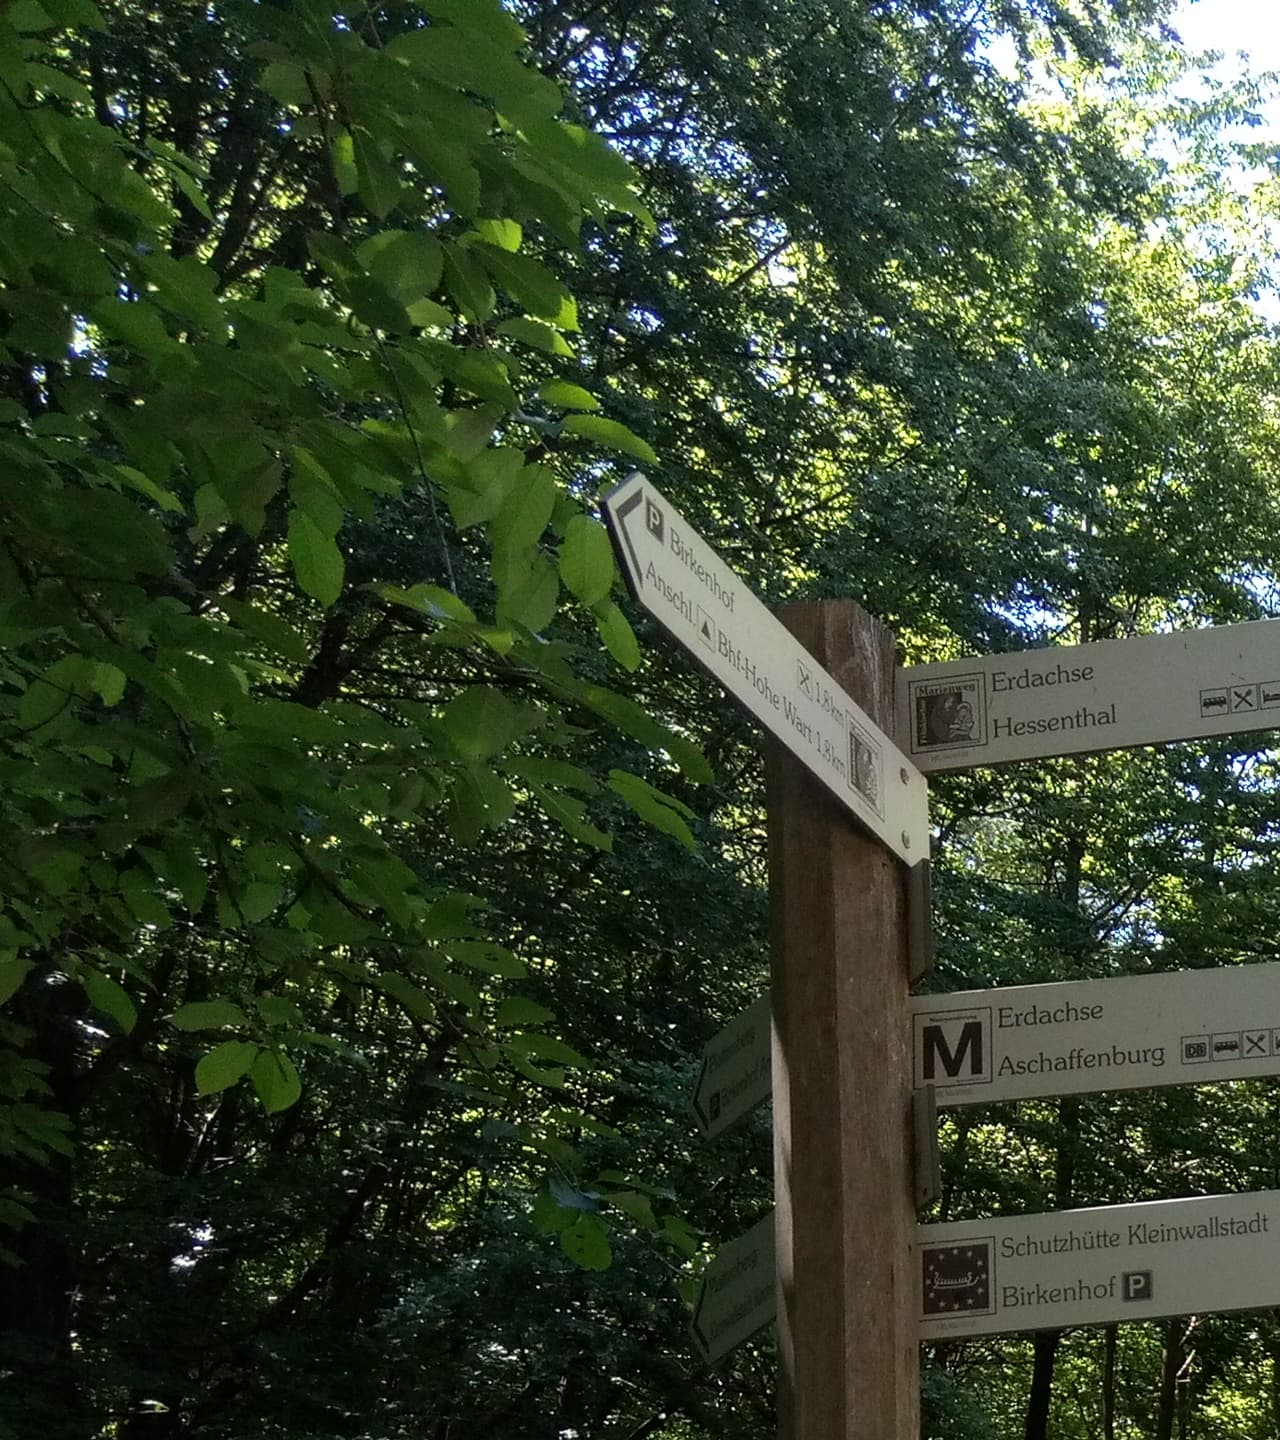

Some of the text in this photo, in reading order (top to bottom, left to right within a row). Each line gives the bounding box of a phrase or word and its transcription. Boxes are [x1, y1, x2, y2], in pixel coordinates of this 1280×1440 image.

[670, 527, 735, 613] Birkenhof
[646, 561, 696, 626] Anschl.
[783, 696, 812, 744] Wart
[992, 664, 1094, 692] Erdachse
[993, 703, 1117, 738] Hessenthal
[998, 1002, 1104, 1028] Erdachse
[922, 1021, 983, 1080] M
[998, 1046, 1166, 1077] Aschaffenburg
[1000, 1228, 1121, 1258] Schutzhütte
[1128, 1212, 1270, 1246] Kleinwallstadt
[1002, 1276, 1117, 1308] Birkenhof
